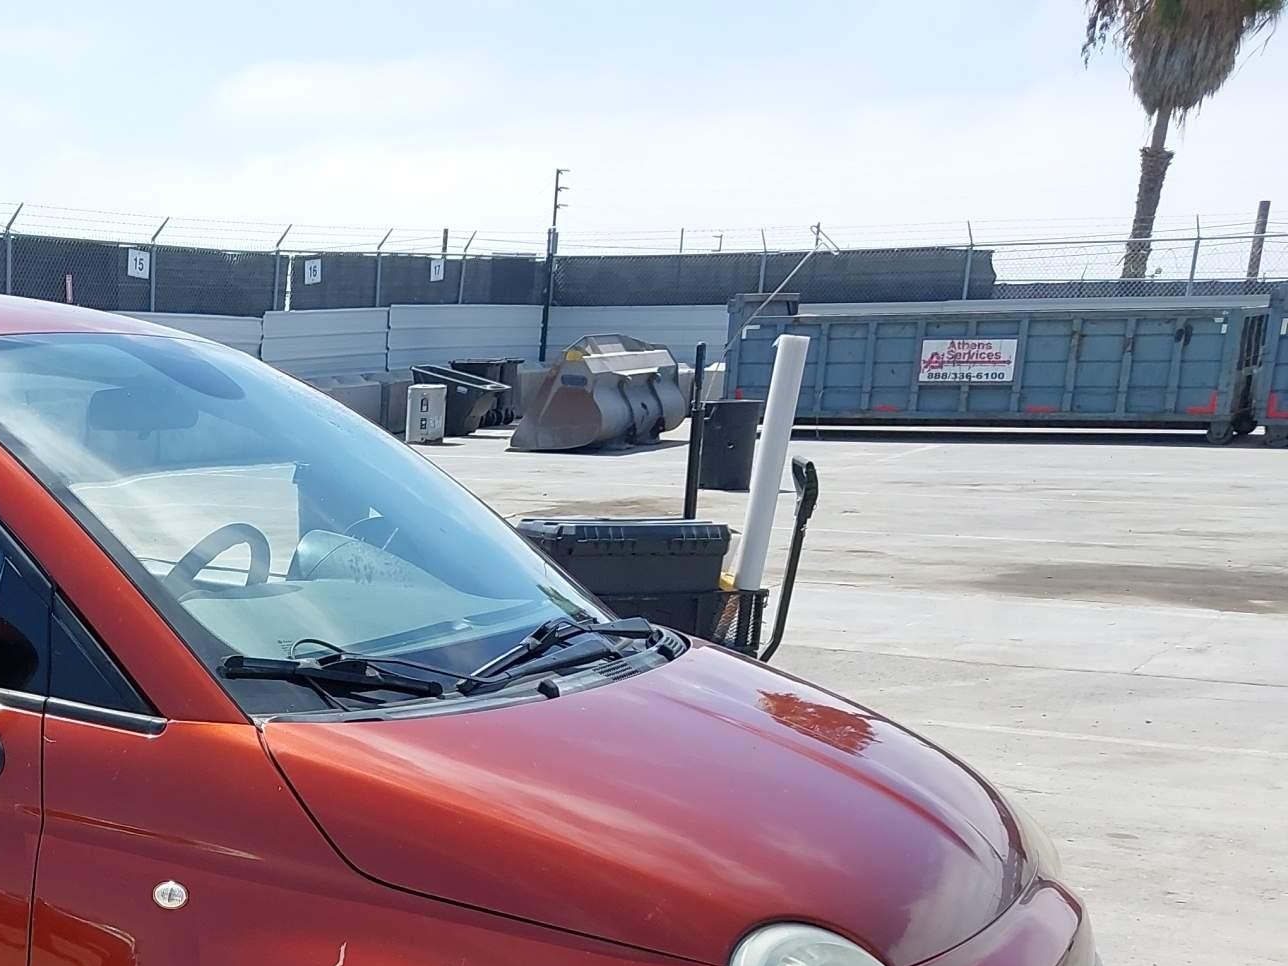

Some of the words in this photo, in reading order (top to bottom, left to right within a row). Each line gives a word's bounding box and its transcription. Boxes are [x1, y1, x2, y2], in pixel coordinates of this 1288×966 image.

[134, 256, 144, 271] 15
[309, 265, 317, 277] 16
[434, 264, 441, 275] 17
[947, 341, 992, 350] Athens
[946, 349, 1001, 360] Services
[927, 372, 1005, 380] 888/336-6100
